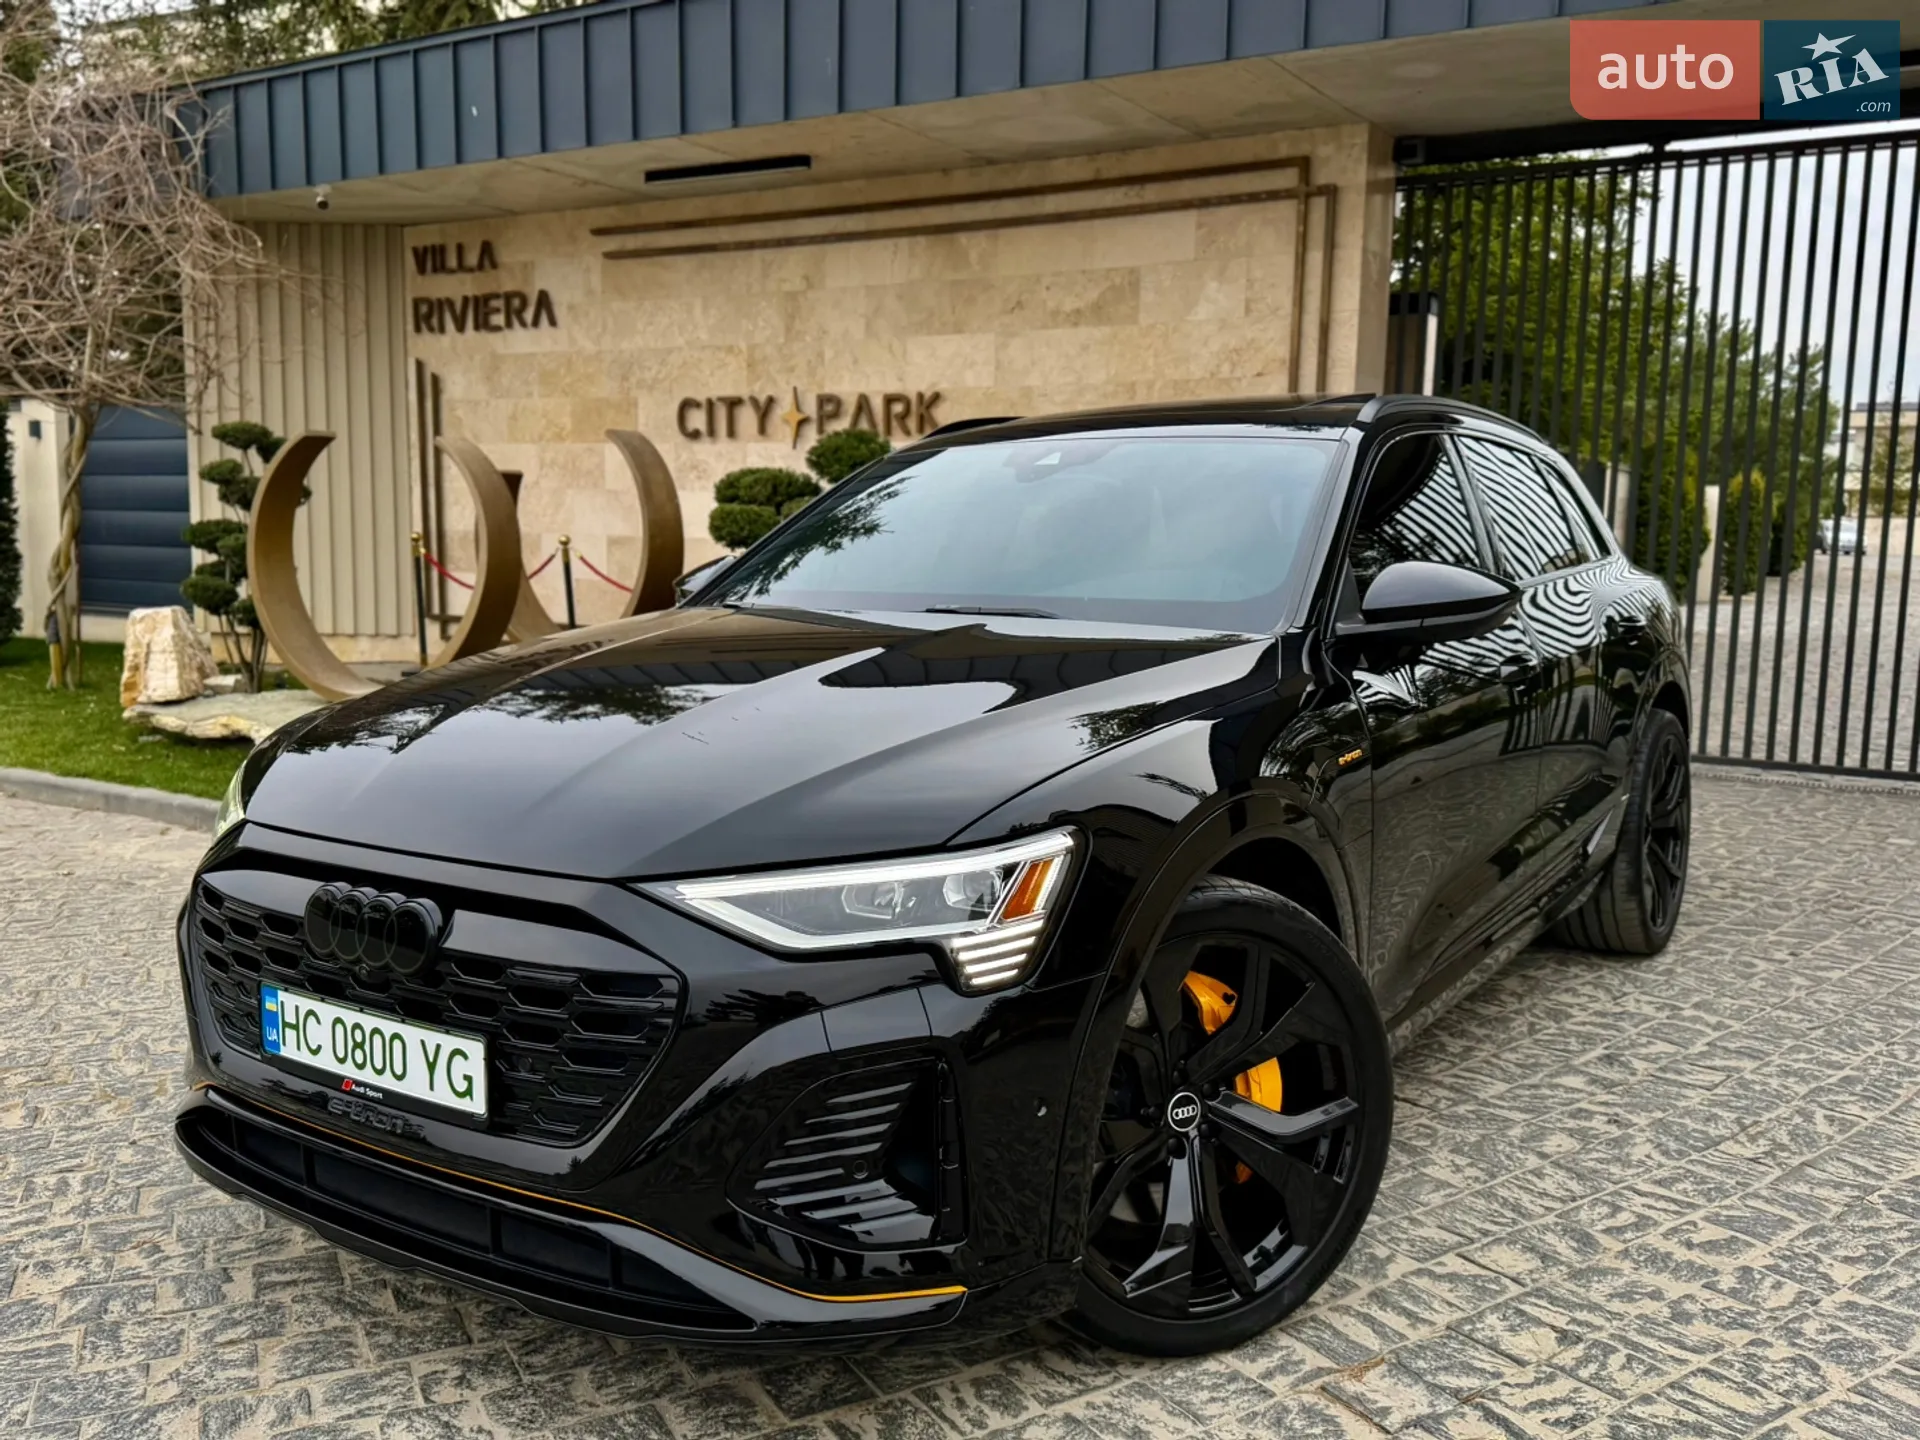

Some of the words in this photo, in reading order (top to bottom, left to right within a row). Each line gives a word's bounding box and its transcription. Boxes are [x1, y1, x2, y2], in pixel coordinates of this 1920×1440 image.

[411, 239, 498, 276] VILLA
[412, 289, 557, 334] RIVIERA
[677, 394, 775, 440] CITY
[815, 391, 942, 437] PARK
[266, 1026, 279, 1043] UA
[280, 1000, 323, 1056] HC
[331, 1015, 407, 1082] 0800
[420, 1038, 474, 1102] YG
